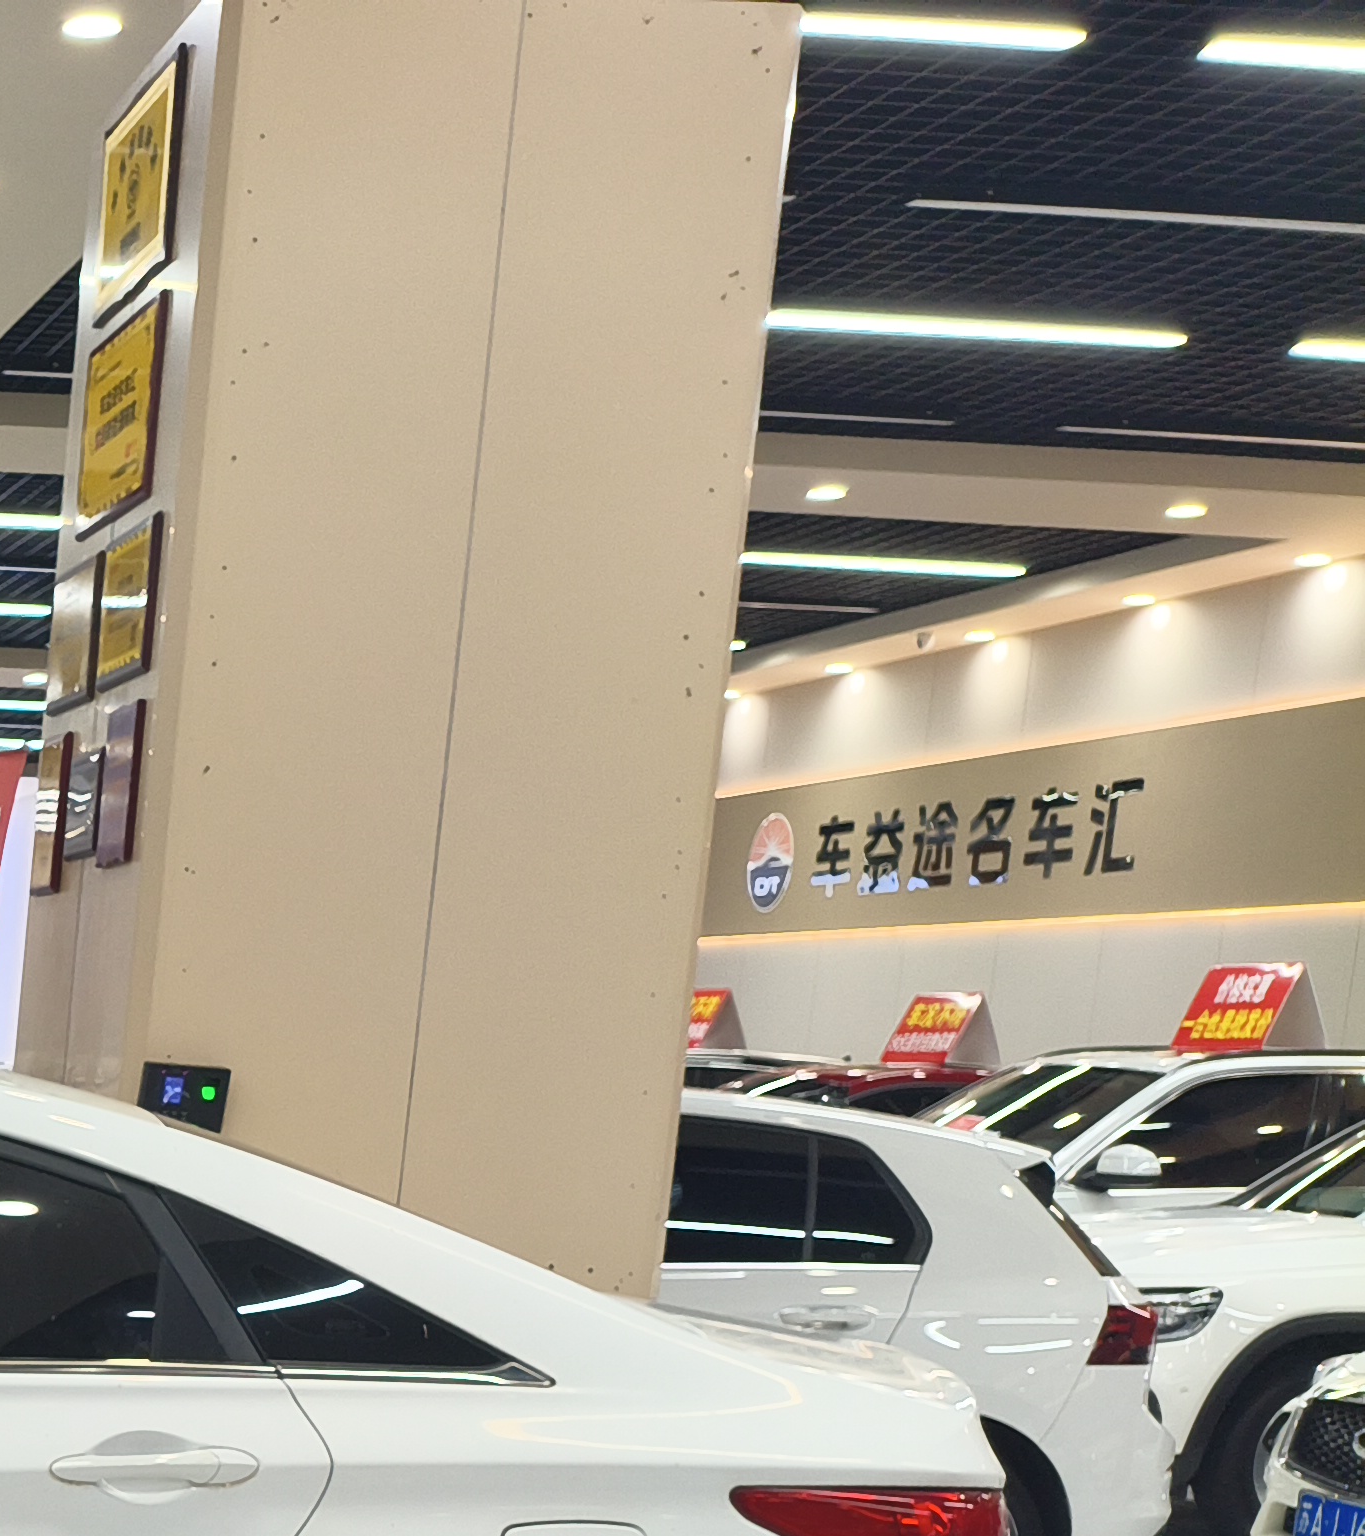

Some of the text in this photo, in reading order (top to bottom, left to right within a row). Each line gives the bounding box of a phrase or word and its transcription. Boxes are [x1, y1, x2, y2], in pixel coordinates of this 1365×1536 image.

[810, 777, 1145, 898] 车益途名车汇
